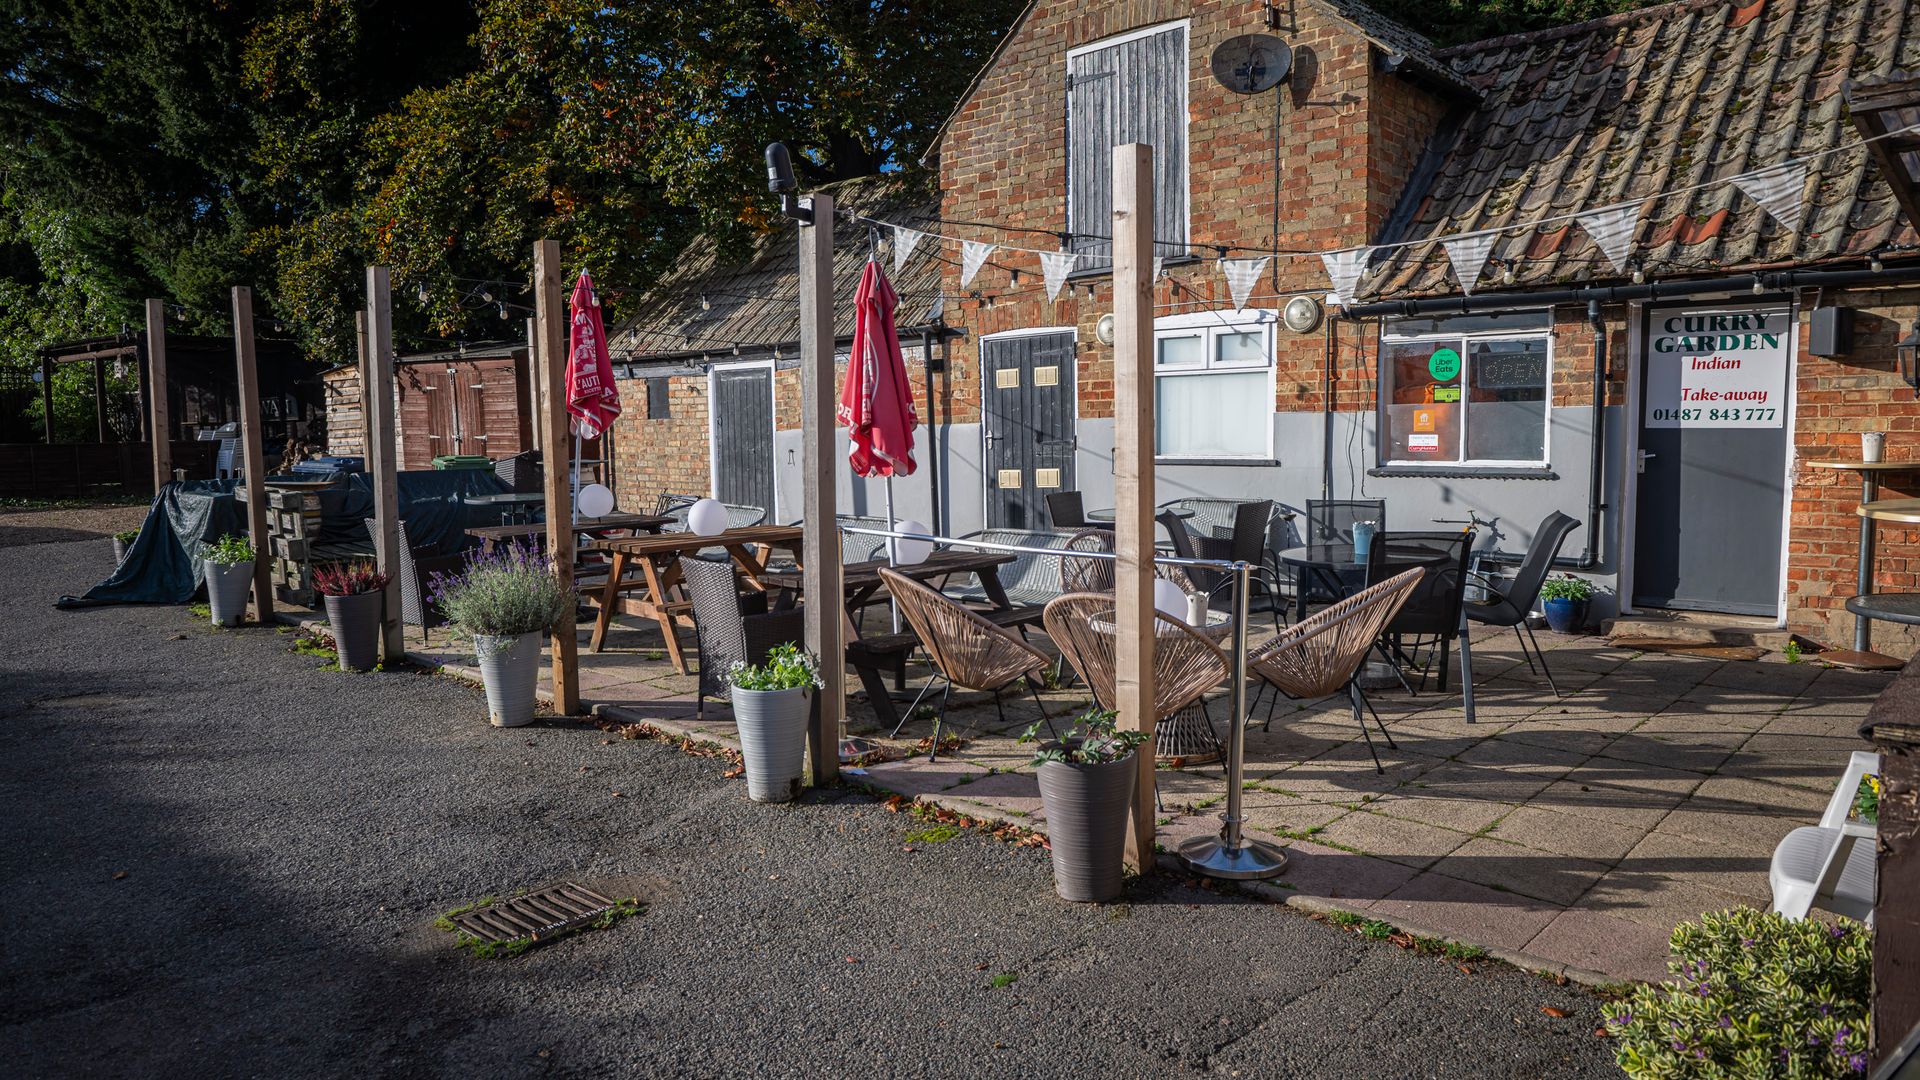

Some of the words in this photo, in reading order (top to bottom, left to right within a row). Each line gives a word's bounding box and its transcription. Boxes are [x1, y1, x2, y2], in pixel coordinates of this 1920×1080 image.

[1664, 313, 1771, 334] CURRY
[1654, 332, 1779, 353] GARDEN
[1435, 365, 1453, 373] Eats
[1485, 362, 1543, 379] OPEN
[1691, 356, 1741, 370] Indian
[1681, 388, 1768, 404] Take-away
[1653, 408, 1702, 421] 01487
[1709, 408, 1740, 421] 843
[1744, 408, 1776, 421] 777
